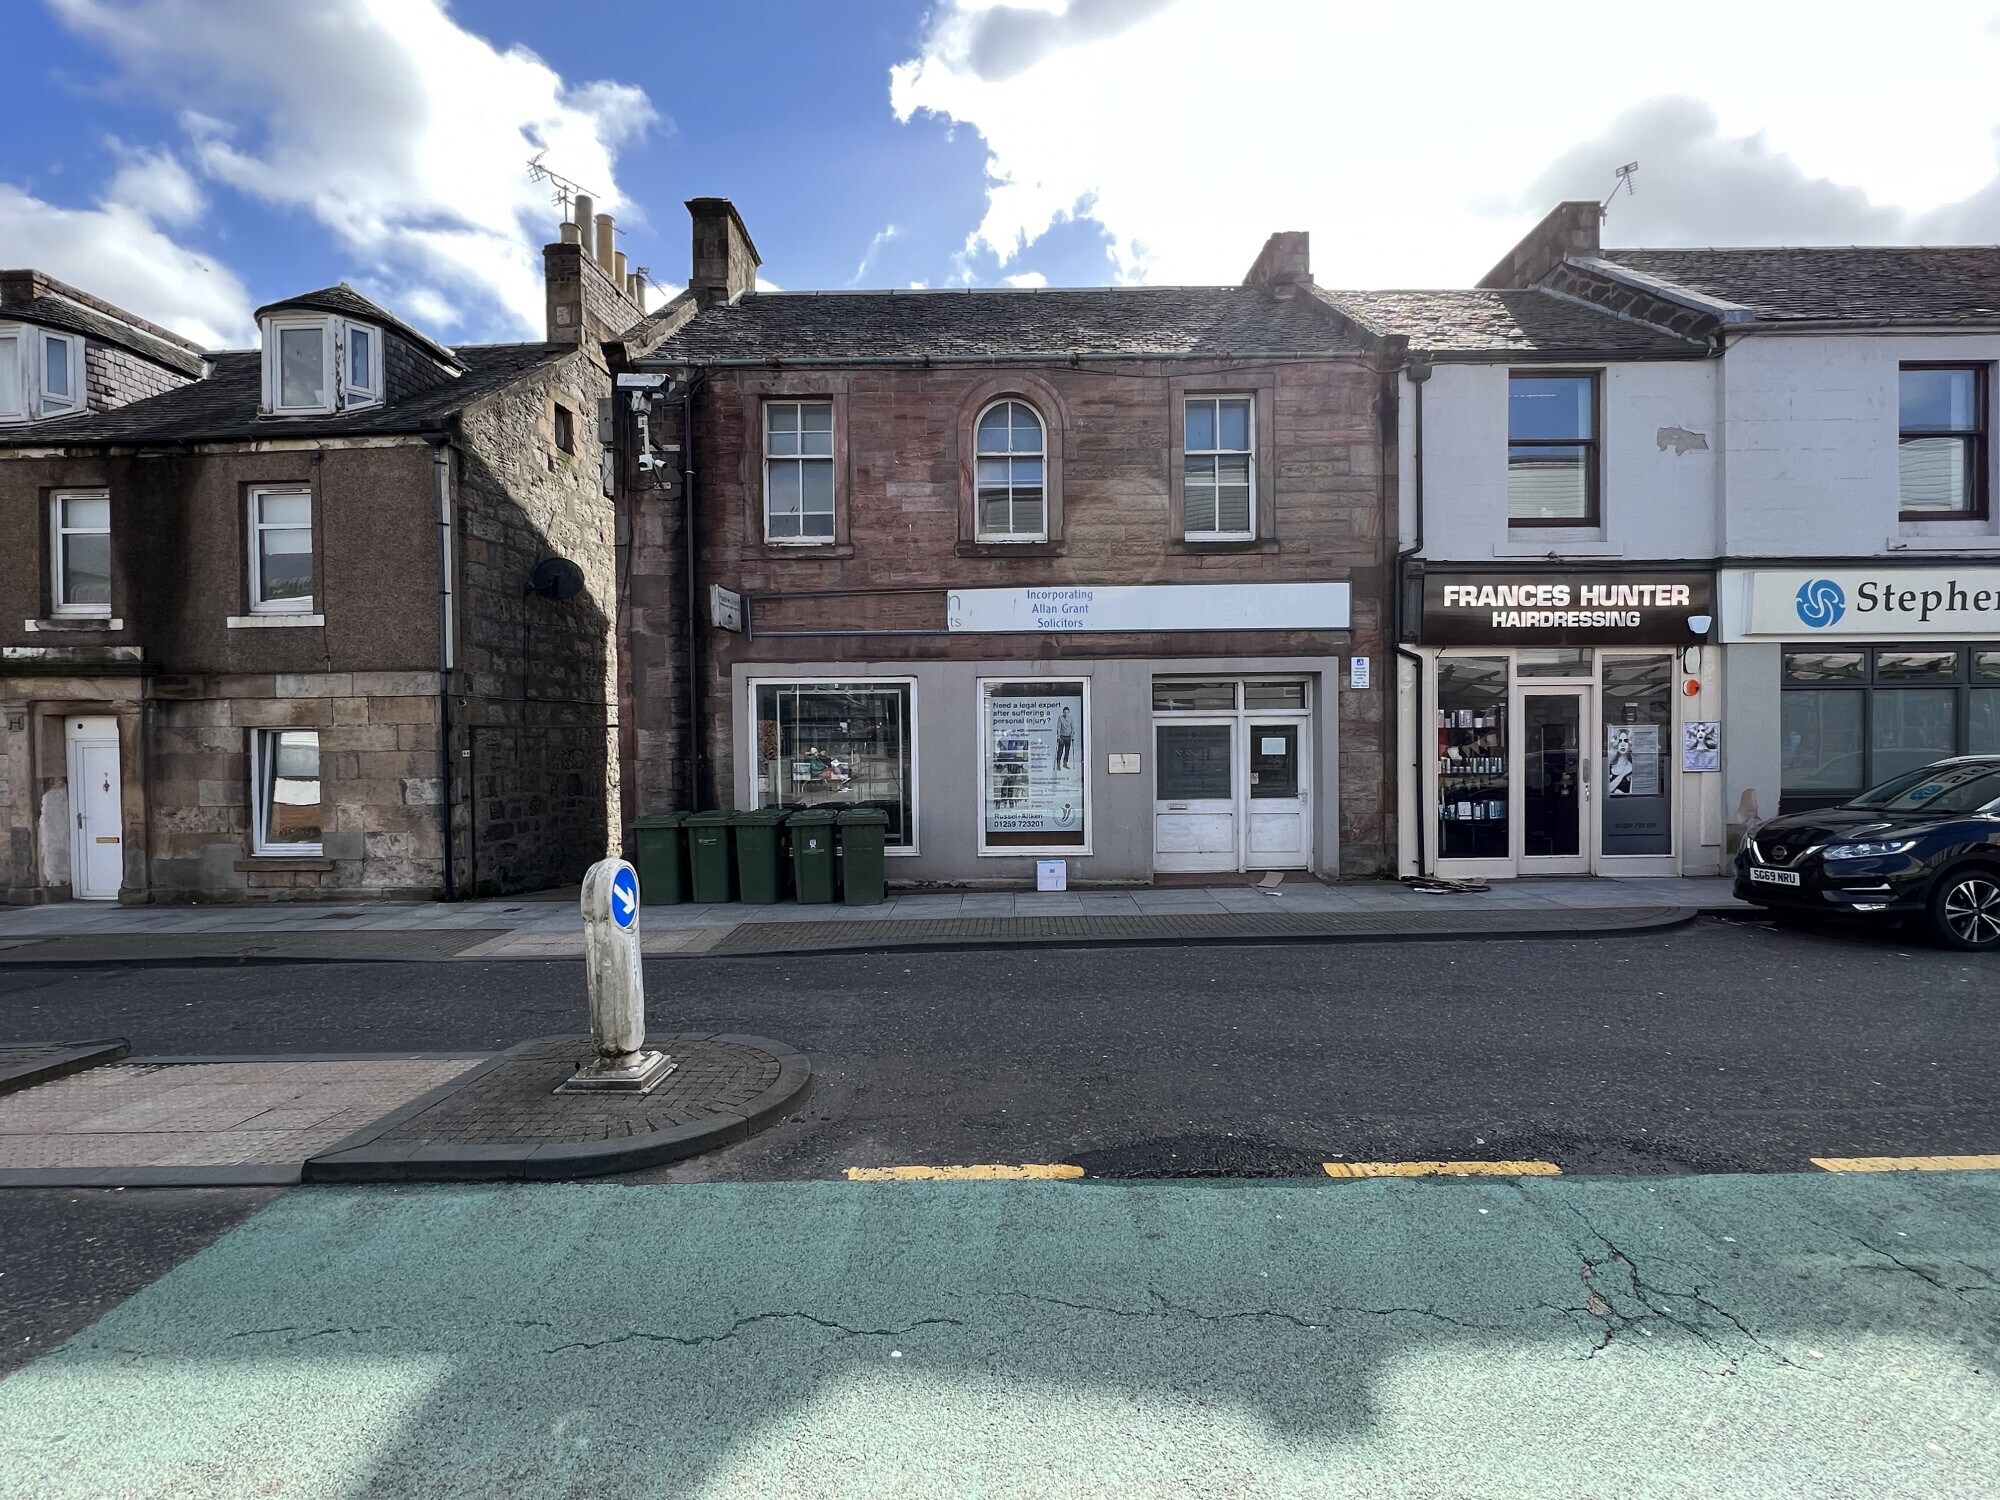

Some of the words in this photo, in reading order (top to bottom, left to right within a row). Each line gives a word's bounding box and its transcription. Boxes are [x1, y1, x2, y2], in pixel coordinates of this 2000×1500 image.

[1027, 589, 1093, 602] Incorporating
[1443, 585, 1571, 607] FRANCES
[1580, 584, 1690, 606] HUNTER
[1031, 603, 1058, 614] Allan
[1061, 603, 1089, 614] Grant
[1037, 617, 1084, 628] Solicitors
[1491, 611, 1641, 628] HAIRDRESSING
[1019, 702, 1037, 710] legal
[1012, 710, 1045, 718] suffering
[993, 718, 1025, 726] personal
[1026, 718, 1051, 726] injury?
[994, 820, 1017, 828] 01259
[1018, 820, 1044, 828] 723201
[1753, 869, 1776, 881] SG69
[1777, 872, 1796, 883] NRU
